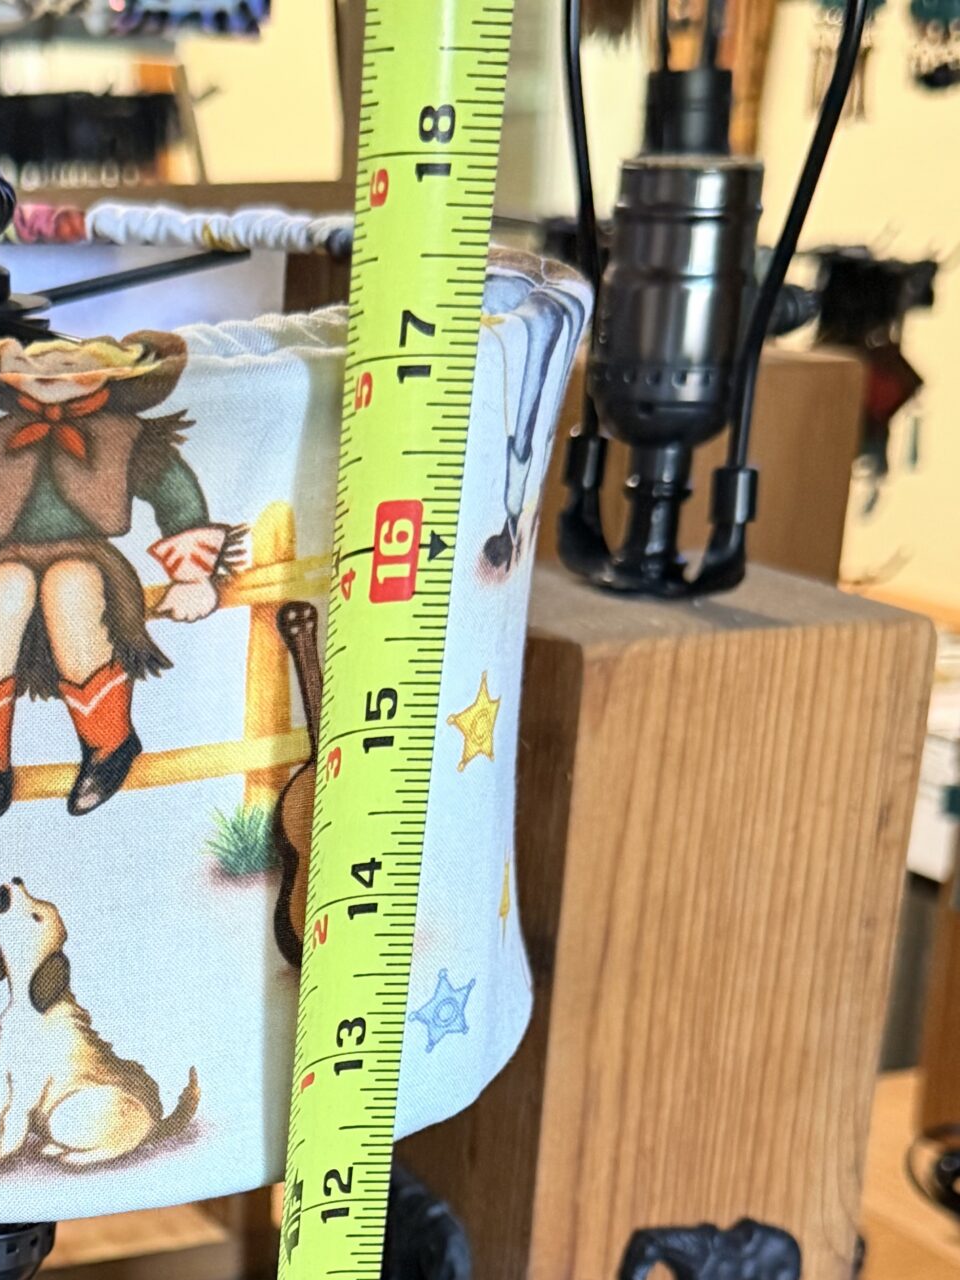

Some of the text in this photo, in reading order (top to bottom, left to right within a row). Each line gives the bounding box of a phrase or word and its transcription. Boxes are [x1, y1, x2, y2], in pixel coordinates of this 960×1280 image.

[415, 104, 457, 182] 18
[370, 168, 389, 208] 6
[397, 309, 436, 384] 17
[354, 371, 373, 409] 5
[375, 516, 414, 585] 16
[339, 569, 356, 601] 4
[363, 687, 398, 753] 15
[325, 747, 342, 779] 3
[348, 857, 382, 920] 14
[313, 915, 328, 946] 2
[334, 1016, 367, 1075] 13
[321, 1166, 353, 1224] 12
